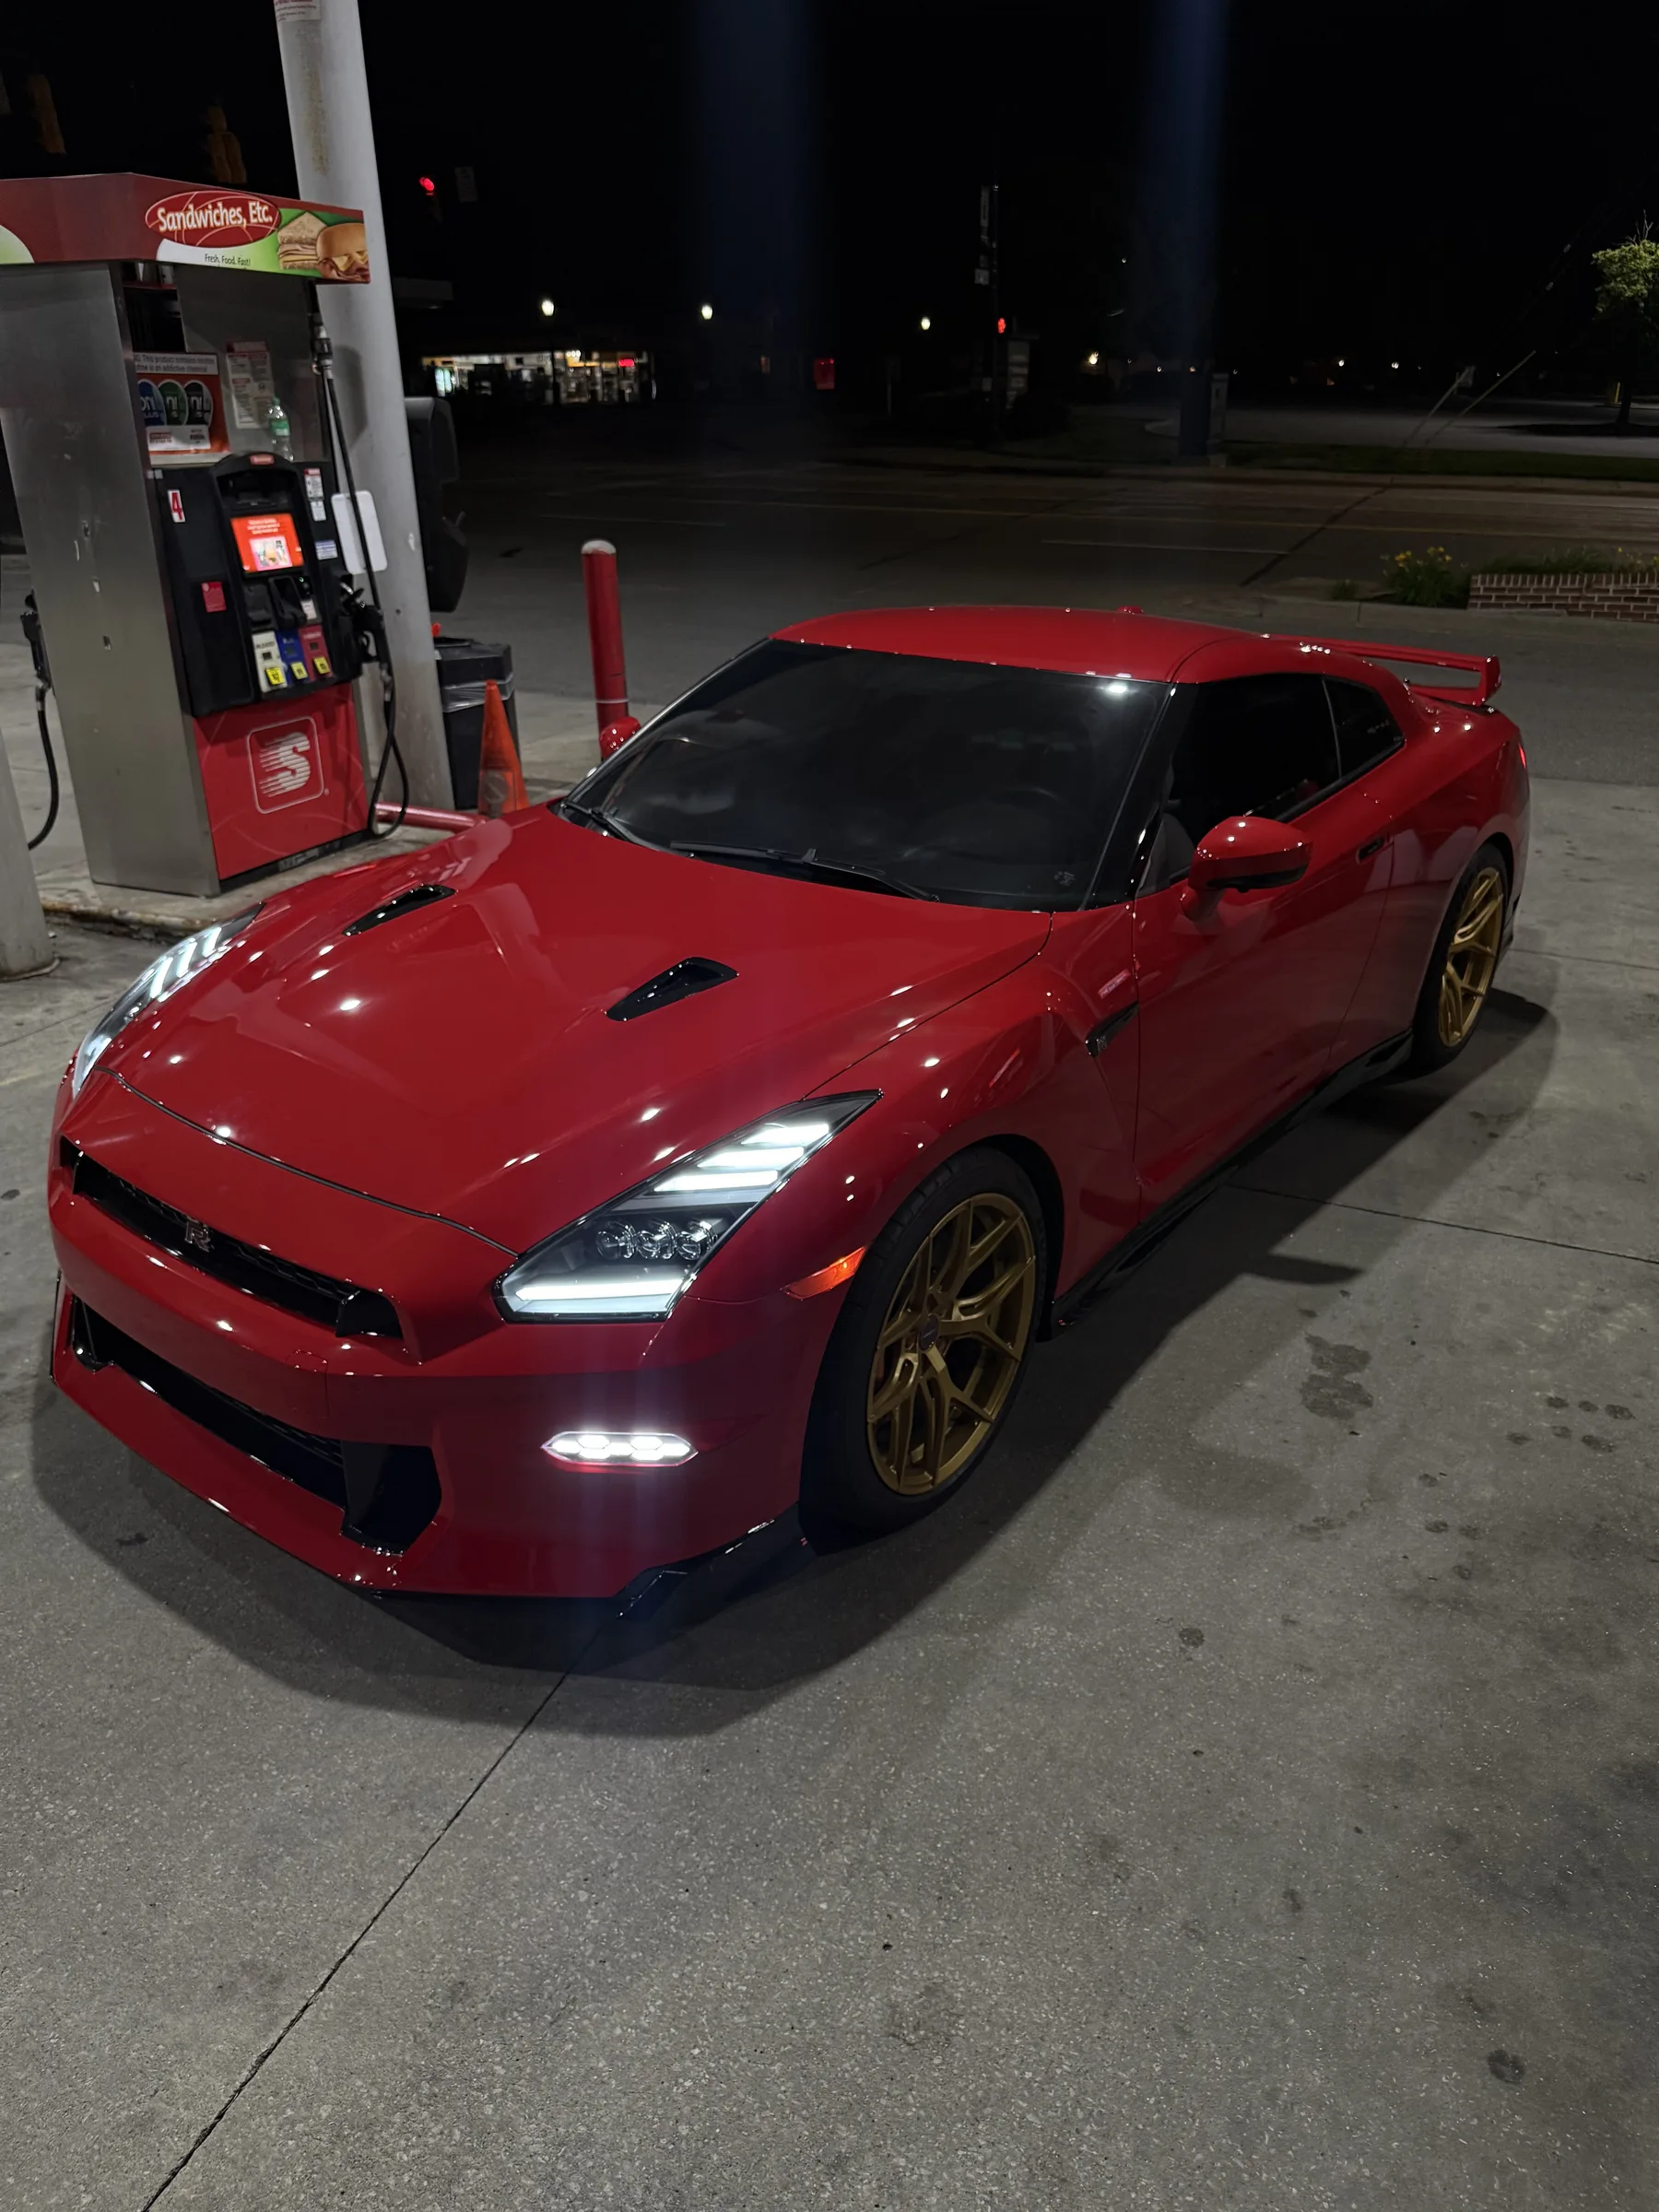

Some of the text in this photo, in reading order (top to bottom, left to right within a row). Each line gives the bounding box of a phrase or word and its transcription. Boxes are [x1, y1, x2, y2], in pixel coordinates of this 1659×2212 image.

[157, 201, 273, 232] Sandwiches, Etc.
[171, 491, 183, 521] 4
